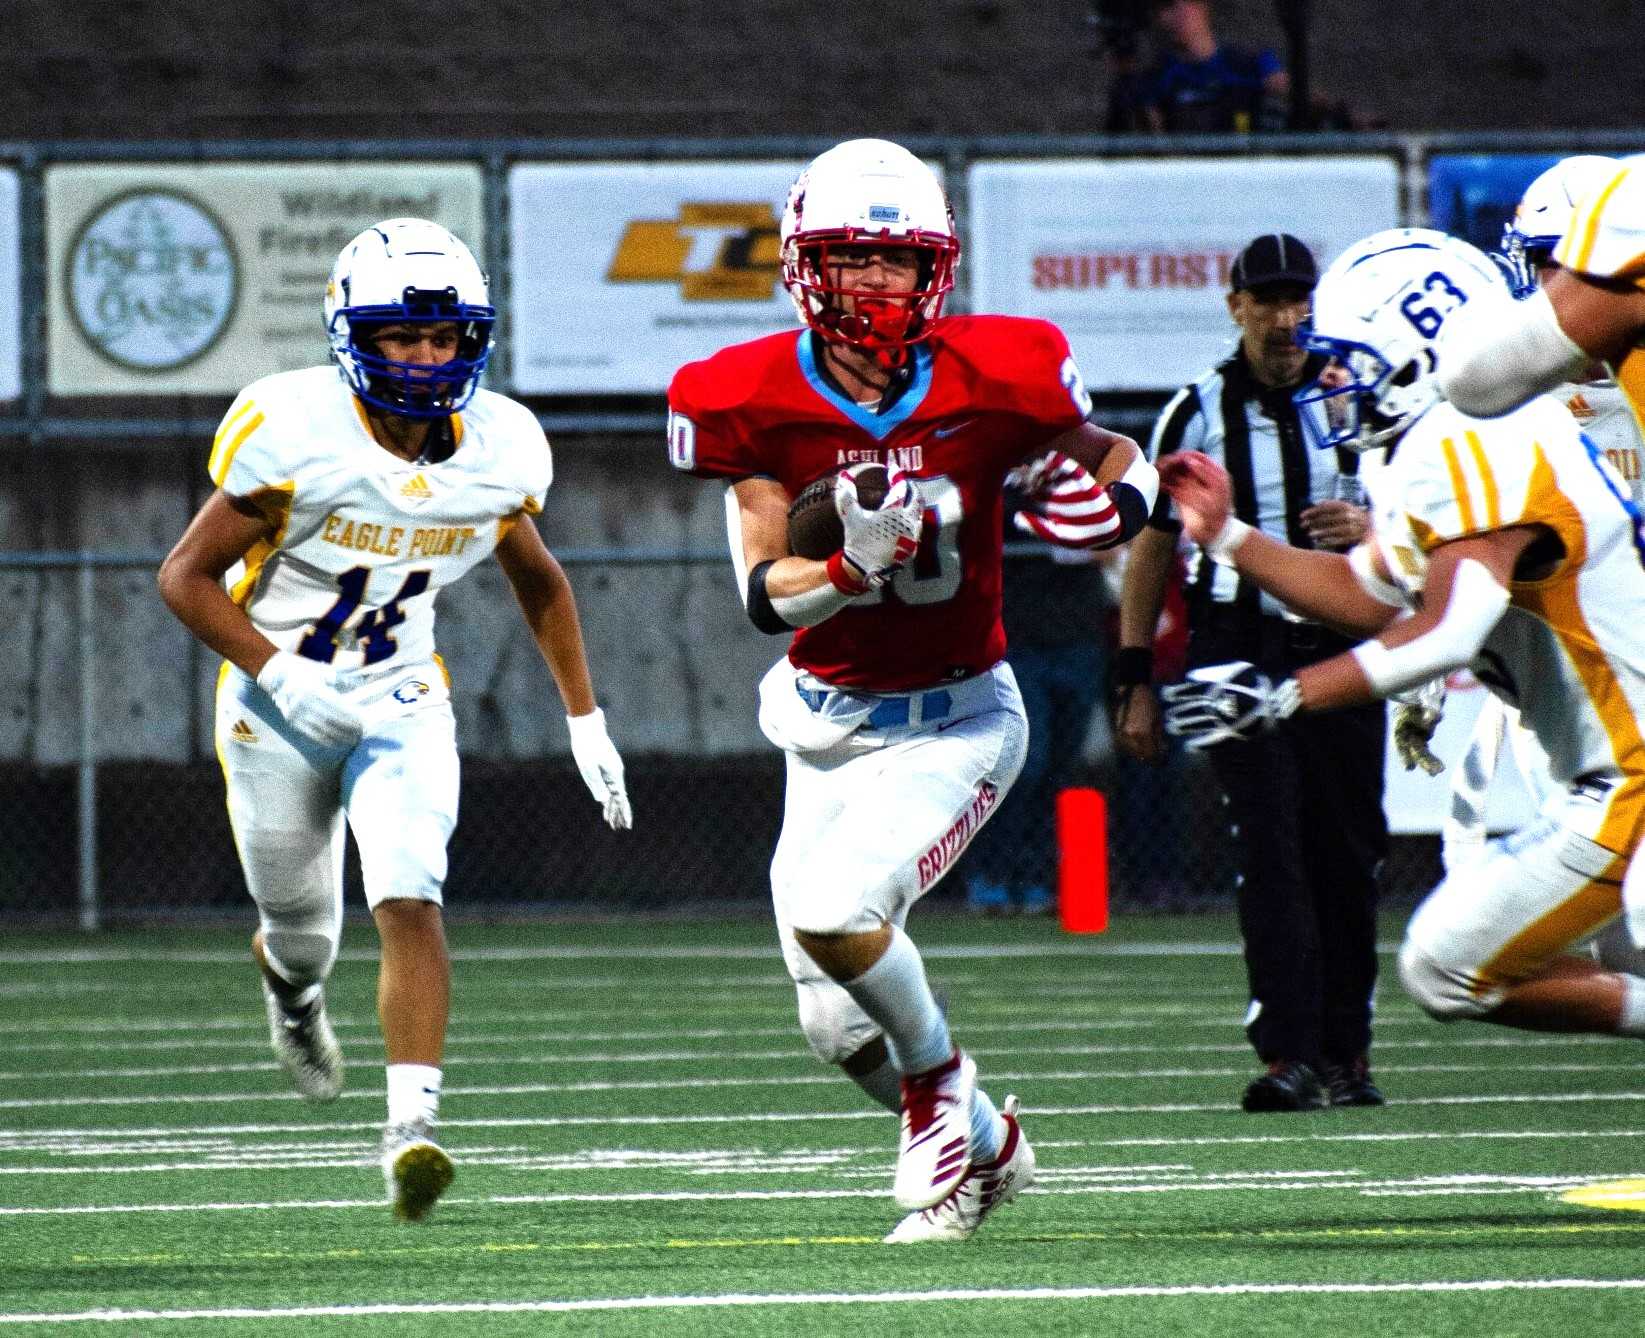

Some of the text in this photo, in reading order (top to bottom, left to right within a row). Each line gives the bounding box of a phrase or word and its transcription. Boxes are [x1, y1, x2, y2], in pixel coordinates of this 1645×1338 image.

[1031, 252, 1236, 291] SUPERST
[1400, 271, 1469, 340] 63
[667, 408, 696, 470] 0
[320, 512, 476, 561] EAGLE POINT
[295, 565, 432, 667] 14
